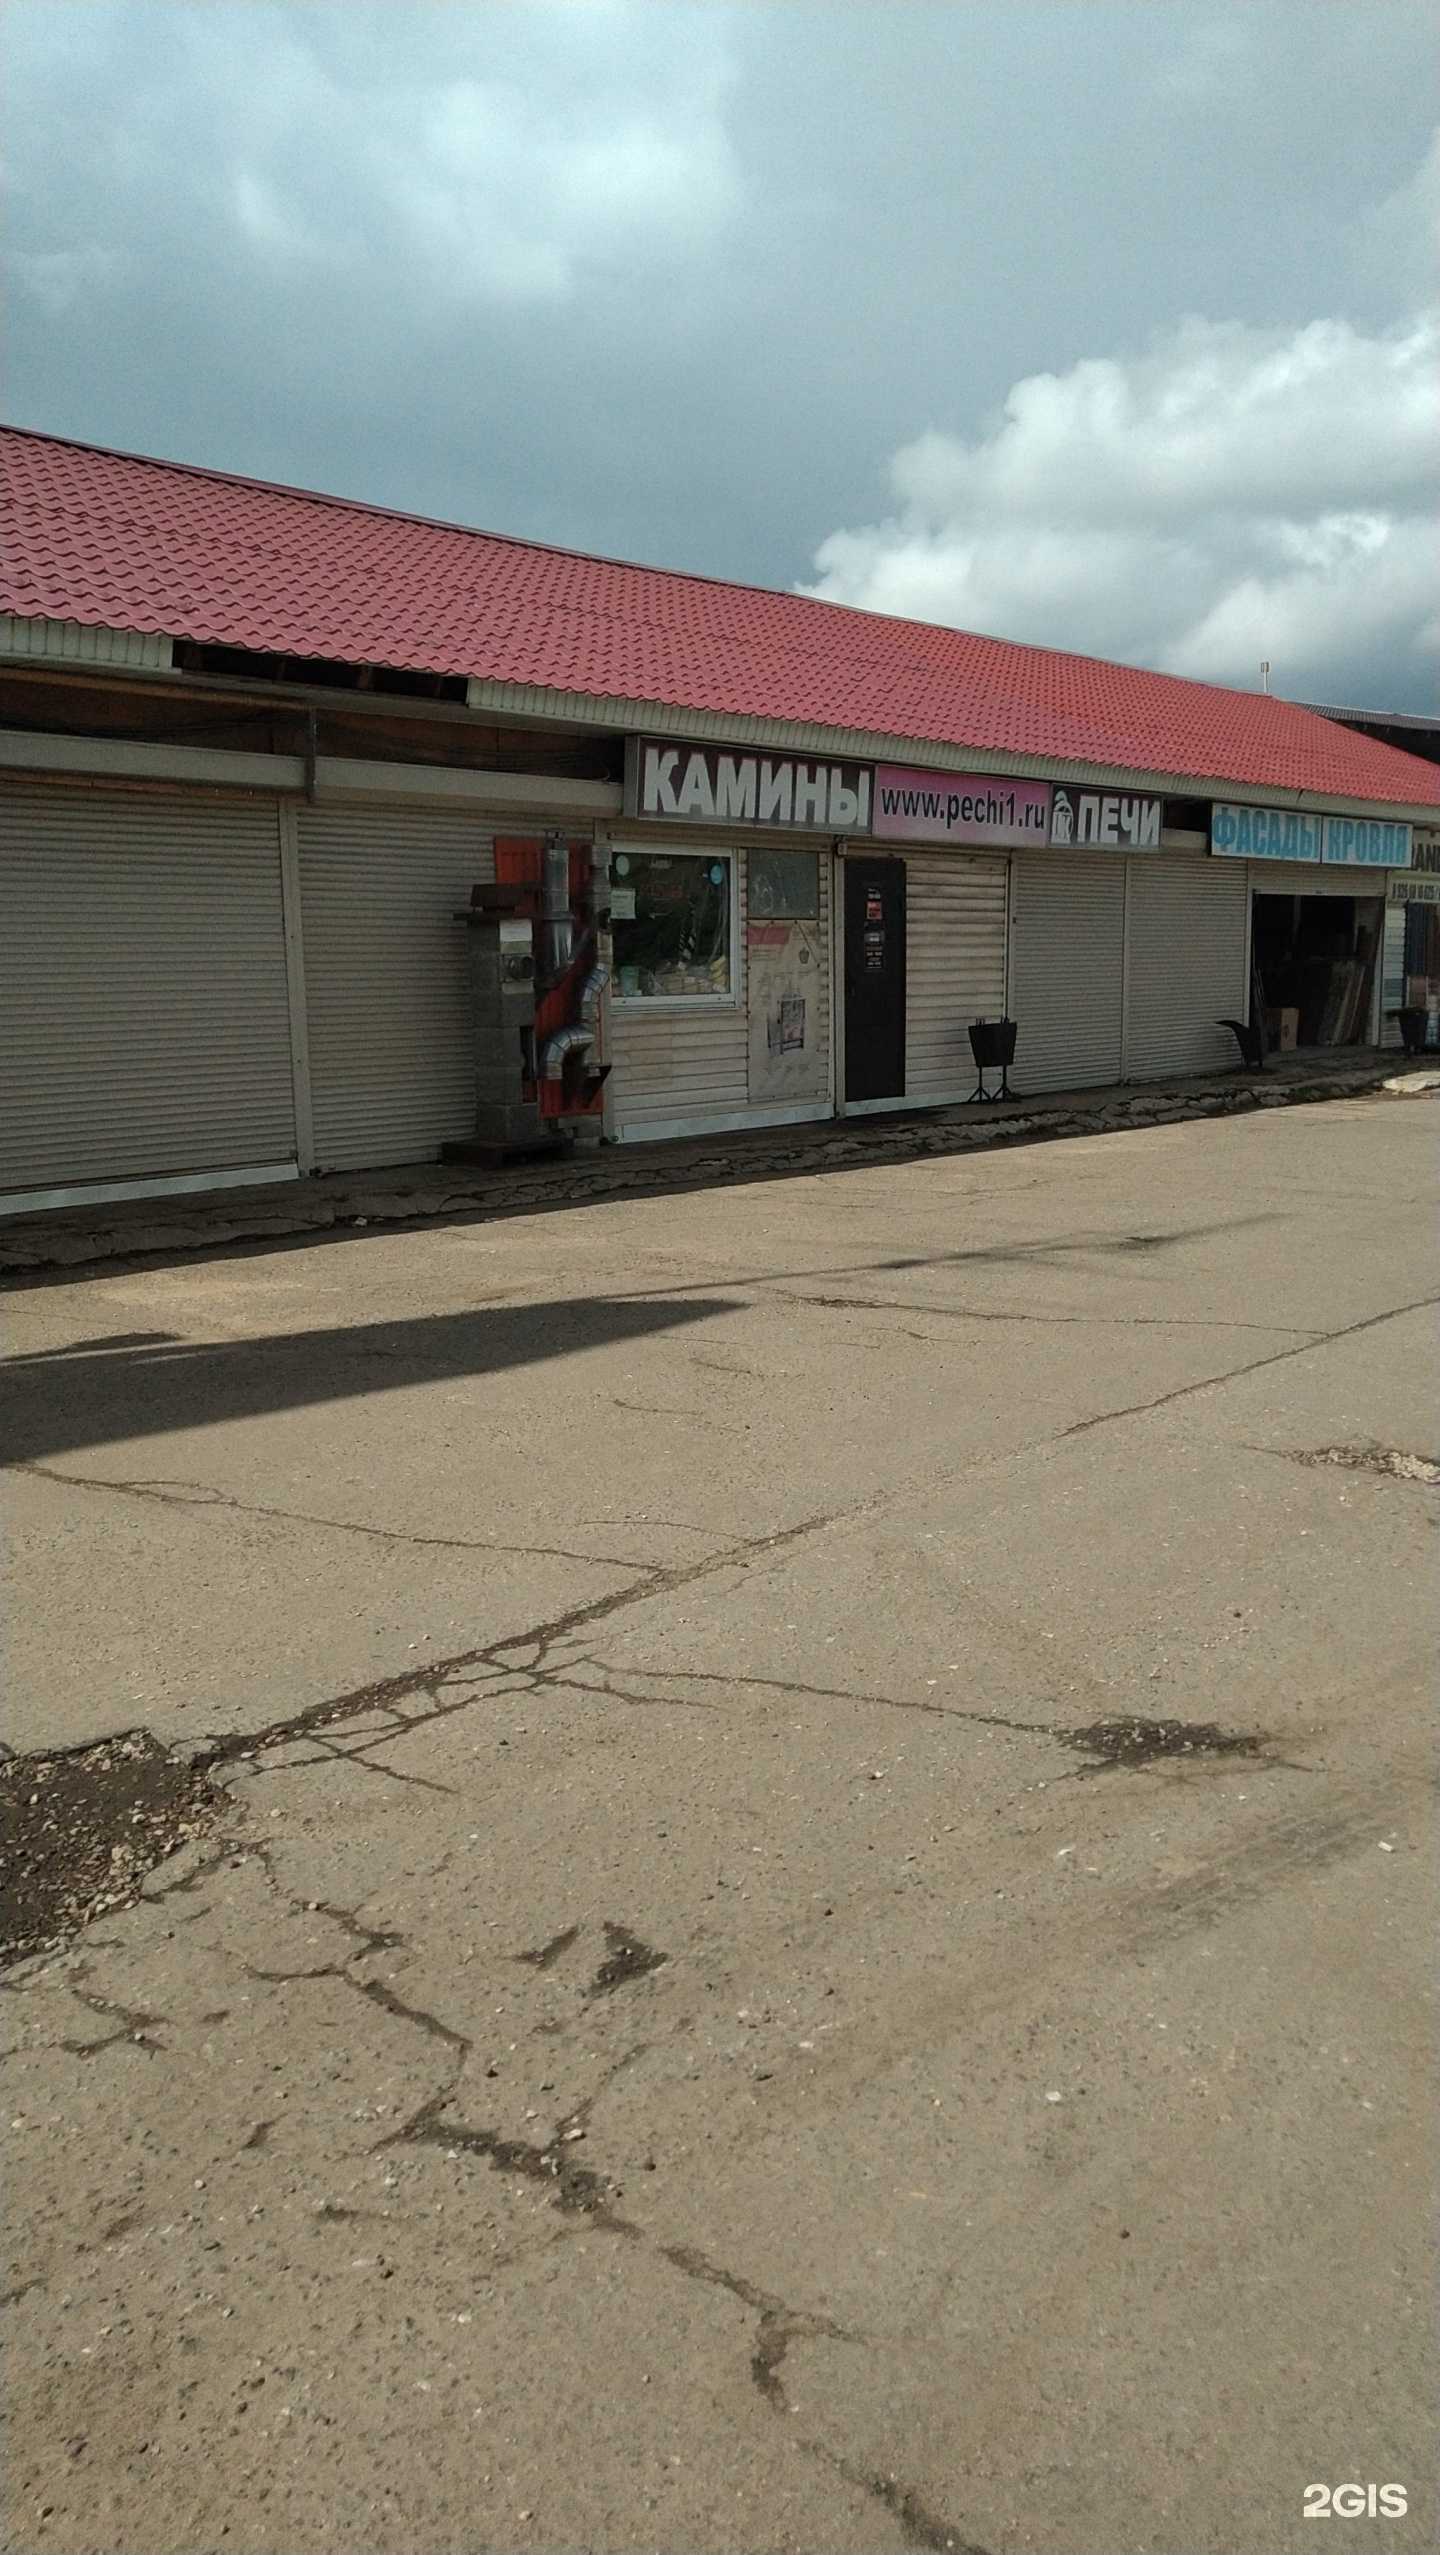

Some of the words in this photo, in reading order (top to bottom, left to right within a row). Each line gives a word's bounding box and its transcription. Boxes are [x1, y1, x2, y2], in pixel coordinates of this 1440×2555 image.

[645, 748, 869, 827] КАМИНЫ
[881, 788, 1044, 829] www.pechi1.ru
[1077, 795, 1161, 845] ПЕЧИ
[1214, 809, 1319, 859] ФАСАДЫ
